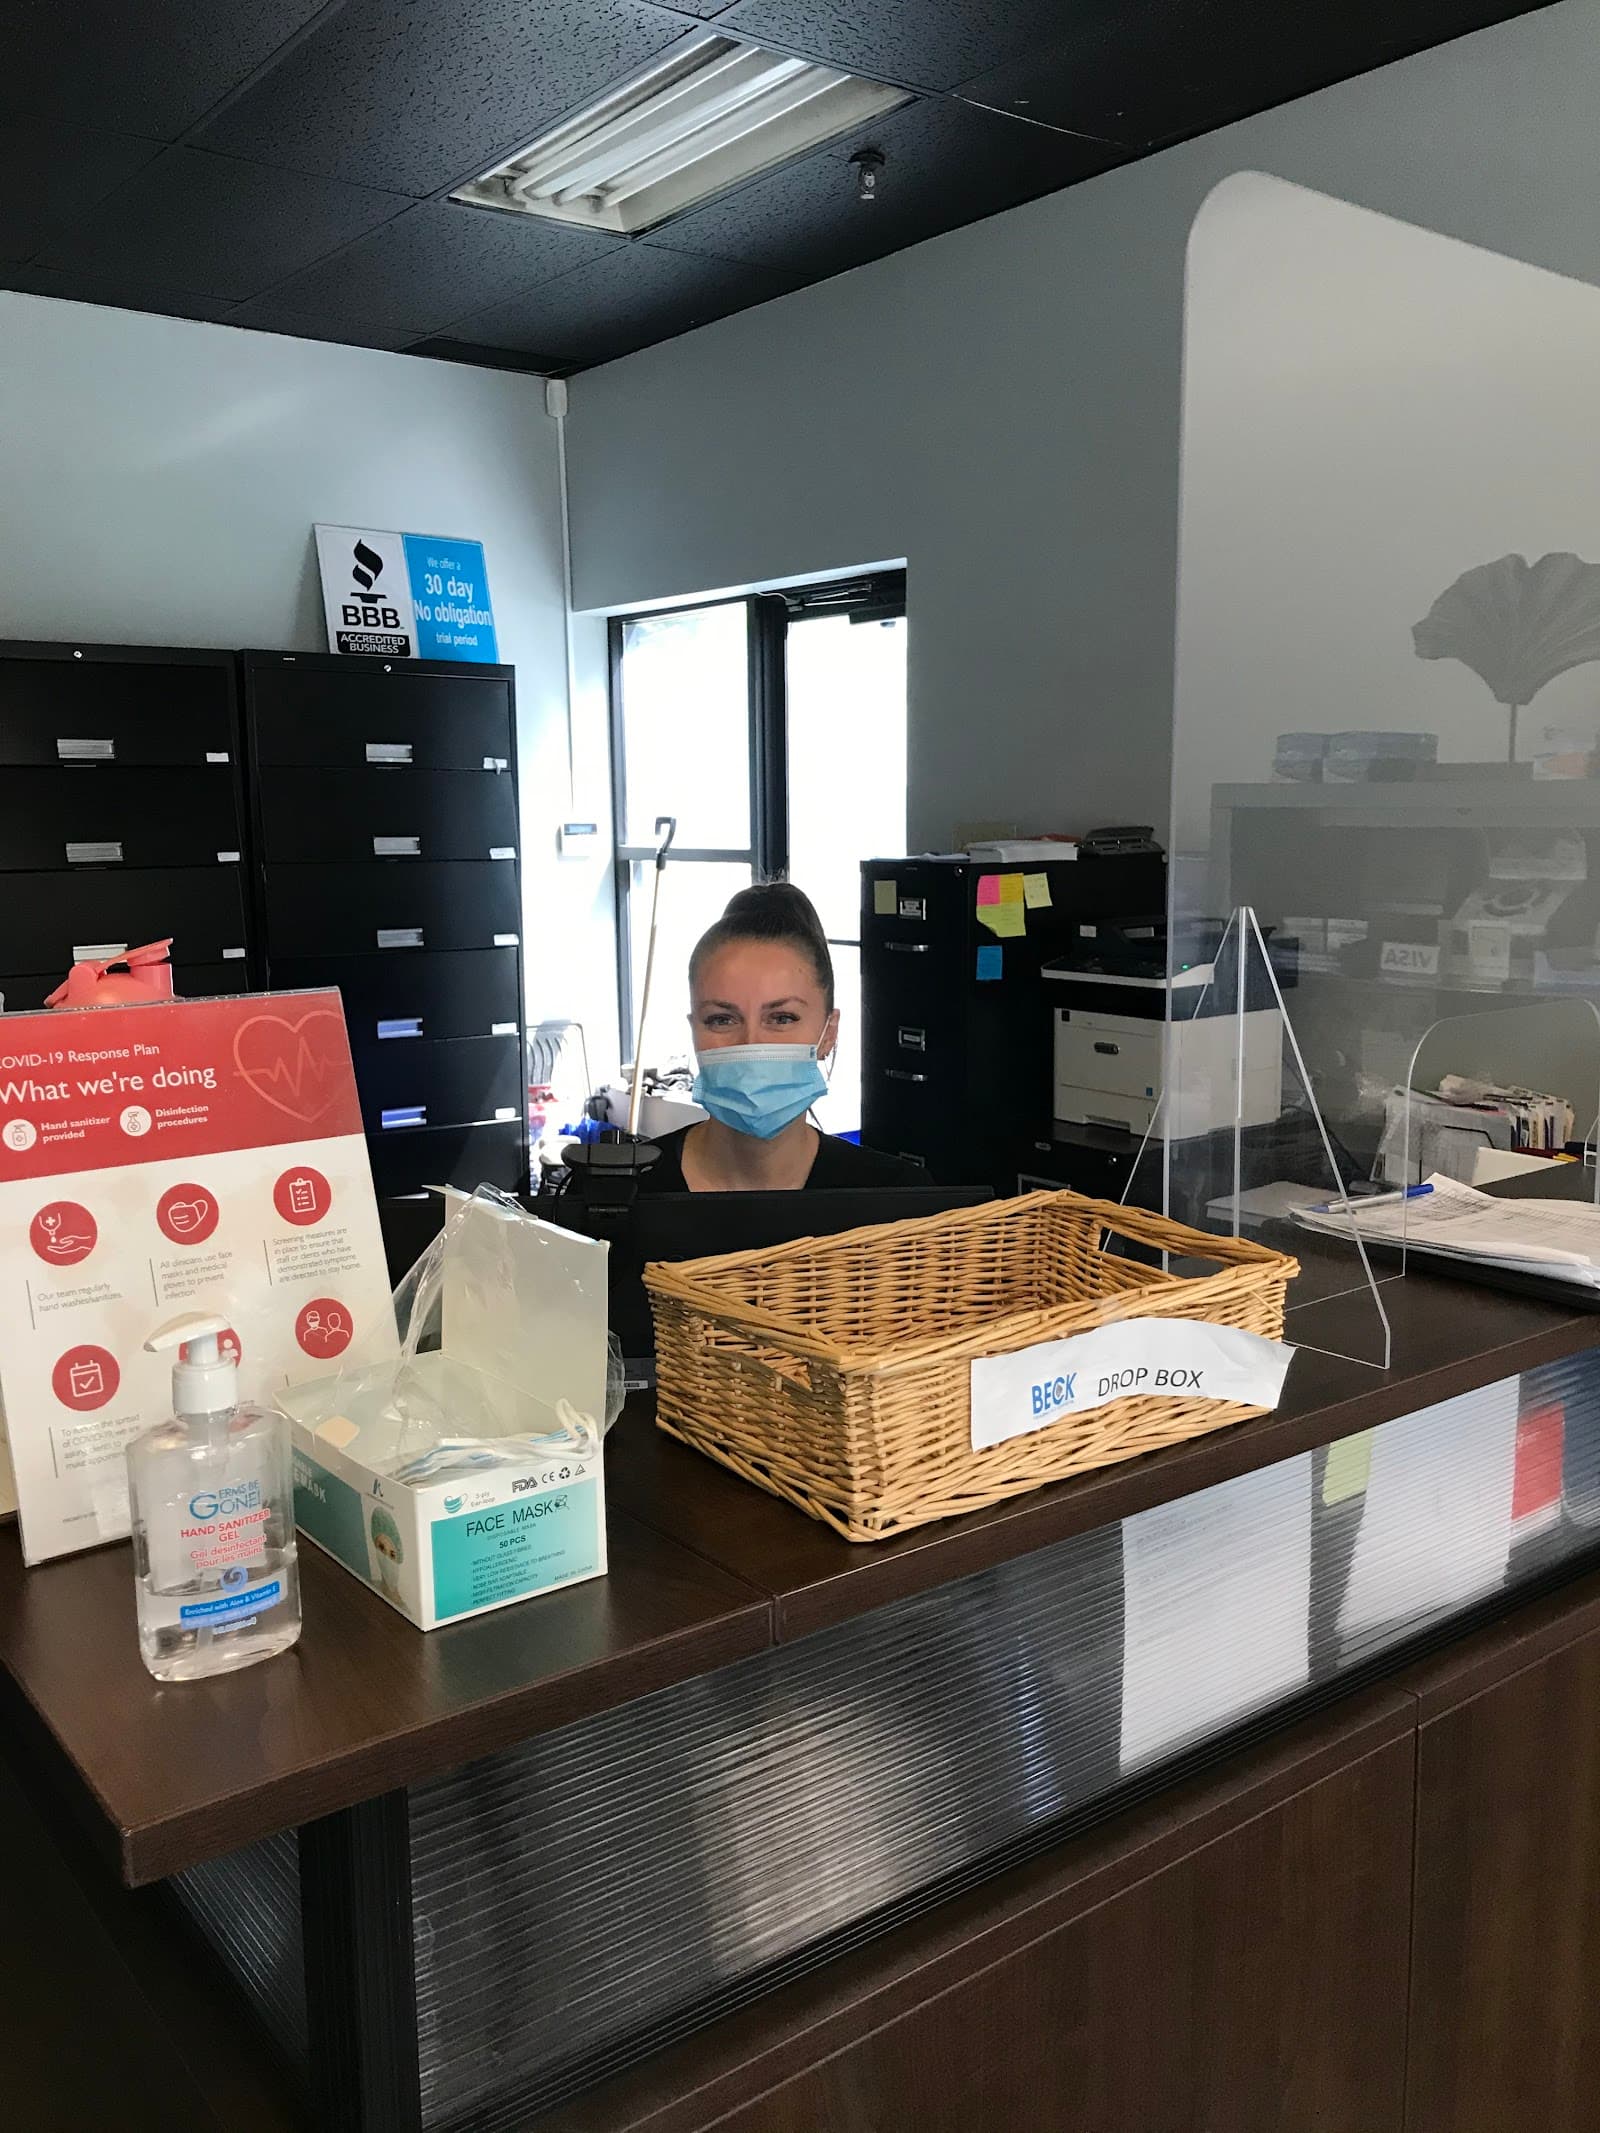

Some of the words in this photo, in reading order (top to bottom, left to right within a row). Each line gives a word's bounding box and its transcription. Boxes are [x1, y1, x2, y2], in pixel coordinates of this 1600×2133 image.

[427, 557, 438, 568] We
[424, 573, 442, 595] 30
[447, 576, 473, 603] day
[342, 605, 400, 629] BBB
[415, 600, 431, 621] No
[435, 602, 492, 629] obligation
[340, 634, 406, 646] ACCREDITED
[436, 632, 451, 645] trial
[453, 635, 478, 647] period
[349, 643, 399, 654] BUSINESS
[67, 1048, 130, 1064] Response
[133, 1044, 160, 1056] Plan
[0, 1080, 71, 1104] What
[77, 1072, 144, 1097] we're
[152, 1066, 217, 1089] doing
[155, 1105, 209, 1118] Disinfection
[41, 1120, 67, 1131] Hand
[70, 1115, 111, 1128] sanitizer
[157, 1115, 208, 1130] procedures
[42, 1130, 86, 1144] provided
[160, 1260, 170, 1269] All
[218, 1251, 232, 1260] face
[185, 1266, 199, 1275] and
[187, 1278, 196, 1286] to
[37, 1293, 54, 1302] Our
[56, 1289, 77, 1298] team
[1032, 1372, 1077, 1415] BECK
[1098, 1367, 1148, 1398] DROP
[1155, 1368, 1204, 1389] BOX
[512, 1476, 538, 1493] FDA
[181, 1525, 216, 1538] HAND
[218, 1508, 271, 1532] SANITIZER
[466, 1513, 505, 1537] FACE
[512, 1499, 554, 1525] MASK
[219, 1530, 240, 1542] GEL
[499, 1540, 508, 1549] 50
[510, 1535, 526, 1546] PCS
[190, 1549, 208, 1560] Gel
[196, 1558, 220, 1569] pour
[222, 1554, 235, 1563] les
[237, 1546, 263, 1559] mains
[185, 1604, 213, 1616] Enriched
[214, 1602, 229, 1611] with
[229, 1598, 244, 1607] Aloe
